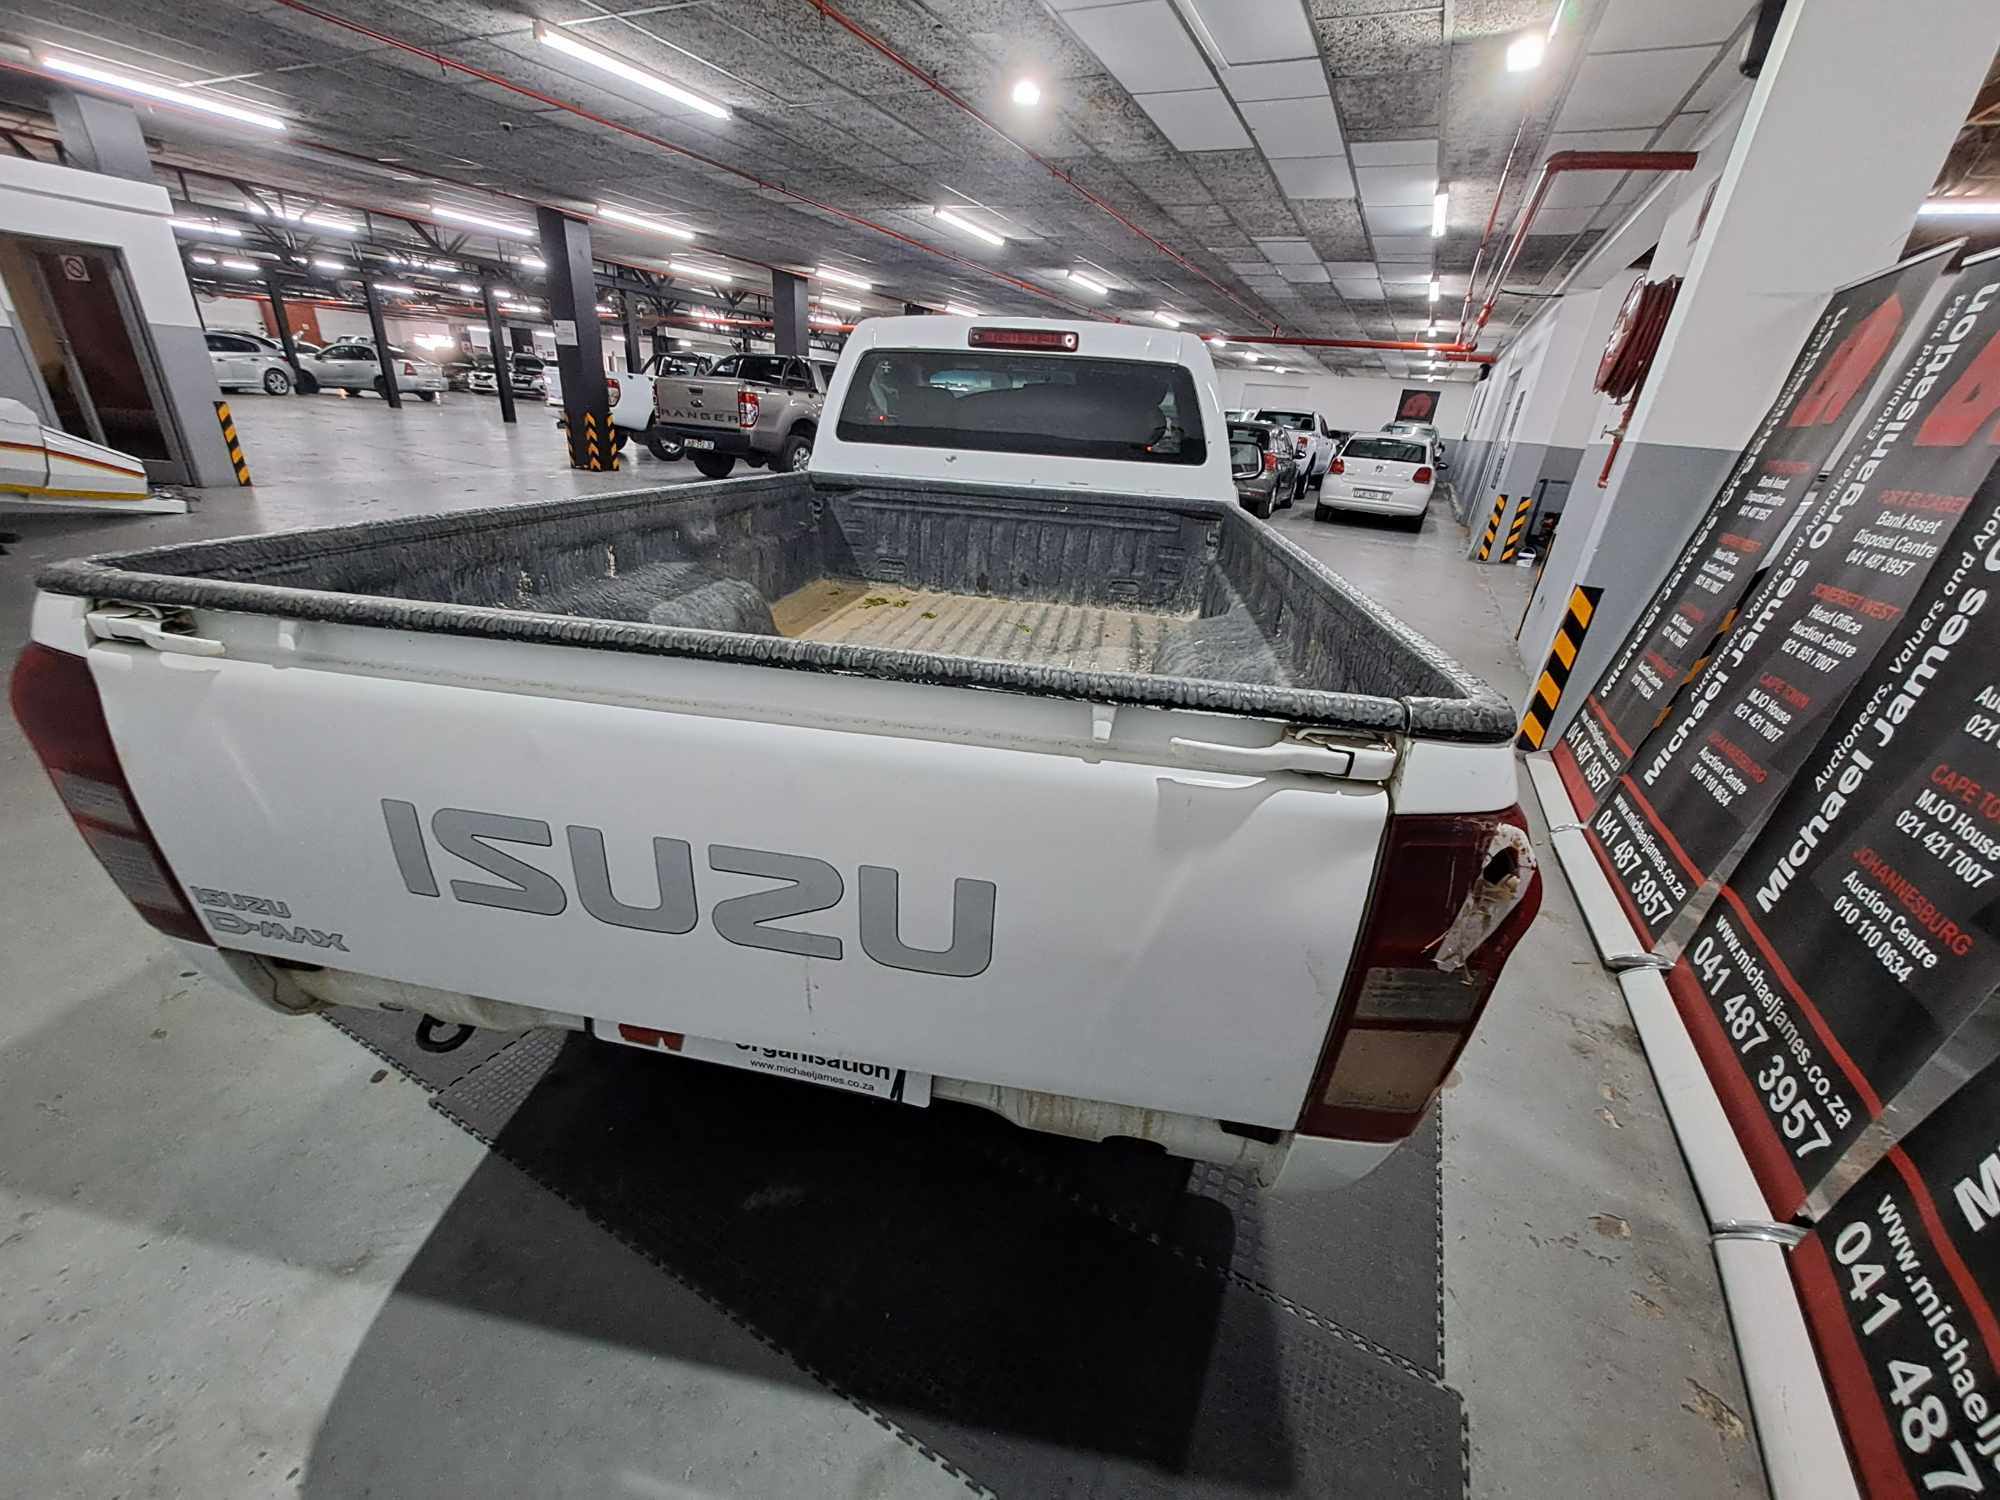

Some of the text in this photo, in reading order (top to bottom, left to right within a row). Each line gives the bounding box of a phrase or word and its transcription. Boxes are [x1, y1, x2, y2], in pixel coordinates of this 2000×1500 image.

[1746, 569, 1784, 619] Valuers
[1784, 537, 1806, 566] and
[1806, 453, 1862, 535] Appraisers
[1866, 343, 1933, 440] Established
[1930, 294, 1966, 341] 1964
[1643, 671, 1729, 787] Michael
[1730, 559, 1810, 668] James
[1809, 282, 2000, 550] Organisation
[1852, 529, 1939, 560] Disposal Centre
[1874, 511, 1943, 535] Bank Asset
[1882, 557, 1916, 578] 3957
[1789, 619, 1857, 659] Auction Centre
[1808, 604, 1836, 629] Head
[1781, 638, 1802, 656] 021
[1814, 650, 1840, 674] 7007
[1814, 552, 1976, 793] Auctioneers, Valuers and
[1747, 688, 1793, 725] MJO House
[1964, 713, 2000, 742] 021
[1583, 757, 1610, 793] 3957
[1697, 746, 1748, 796] Auction Centre
[1755, 586, 1988, 914] Michael James
[1931, 763, 1981, 806] CAPE
[1613, 793, 1687, 901] www.michaeljames.co.za
[1896, 809, 1994, 889] 021 421 7007
[1915, 788, 2000, 862] MJO House
[190, 885, 292, 919] ISUZU
[380, 797, 998, 979] ISUZU
[1596, 809, 1674, 925] 041 487 3957
[1852, 847, 1975, 957] JOHANNESBURG
[202, 908, 351, 952] D-MAX
[1833, 895, 1914, 983] 010 110 0634
[1842, 870, 1939, 969] Auction Centre
[1693, 936, 1832, 1158] 041 487 3957
[1715, 914, 1852, 1129] www.michaeljames.co.za
[750, 1059, 875, 1091] www.michaeljames.co.za
[1835, 1221, 1984, 1493] 041 487
[1876, 1194, 2000, 1473] www.michaelj
